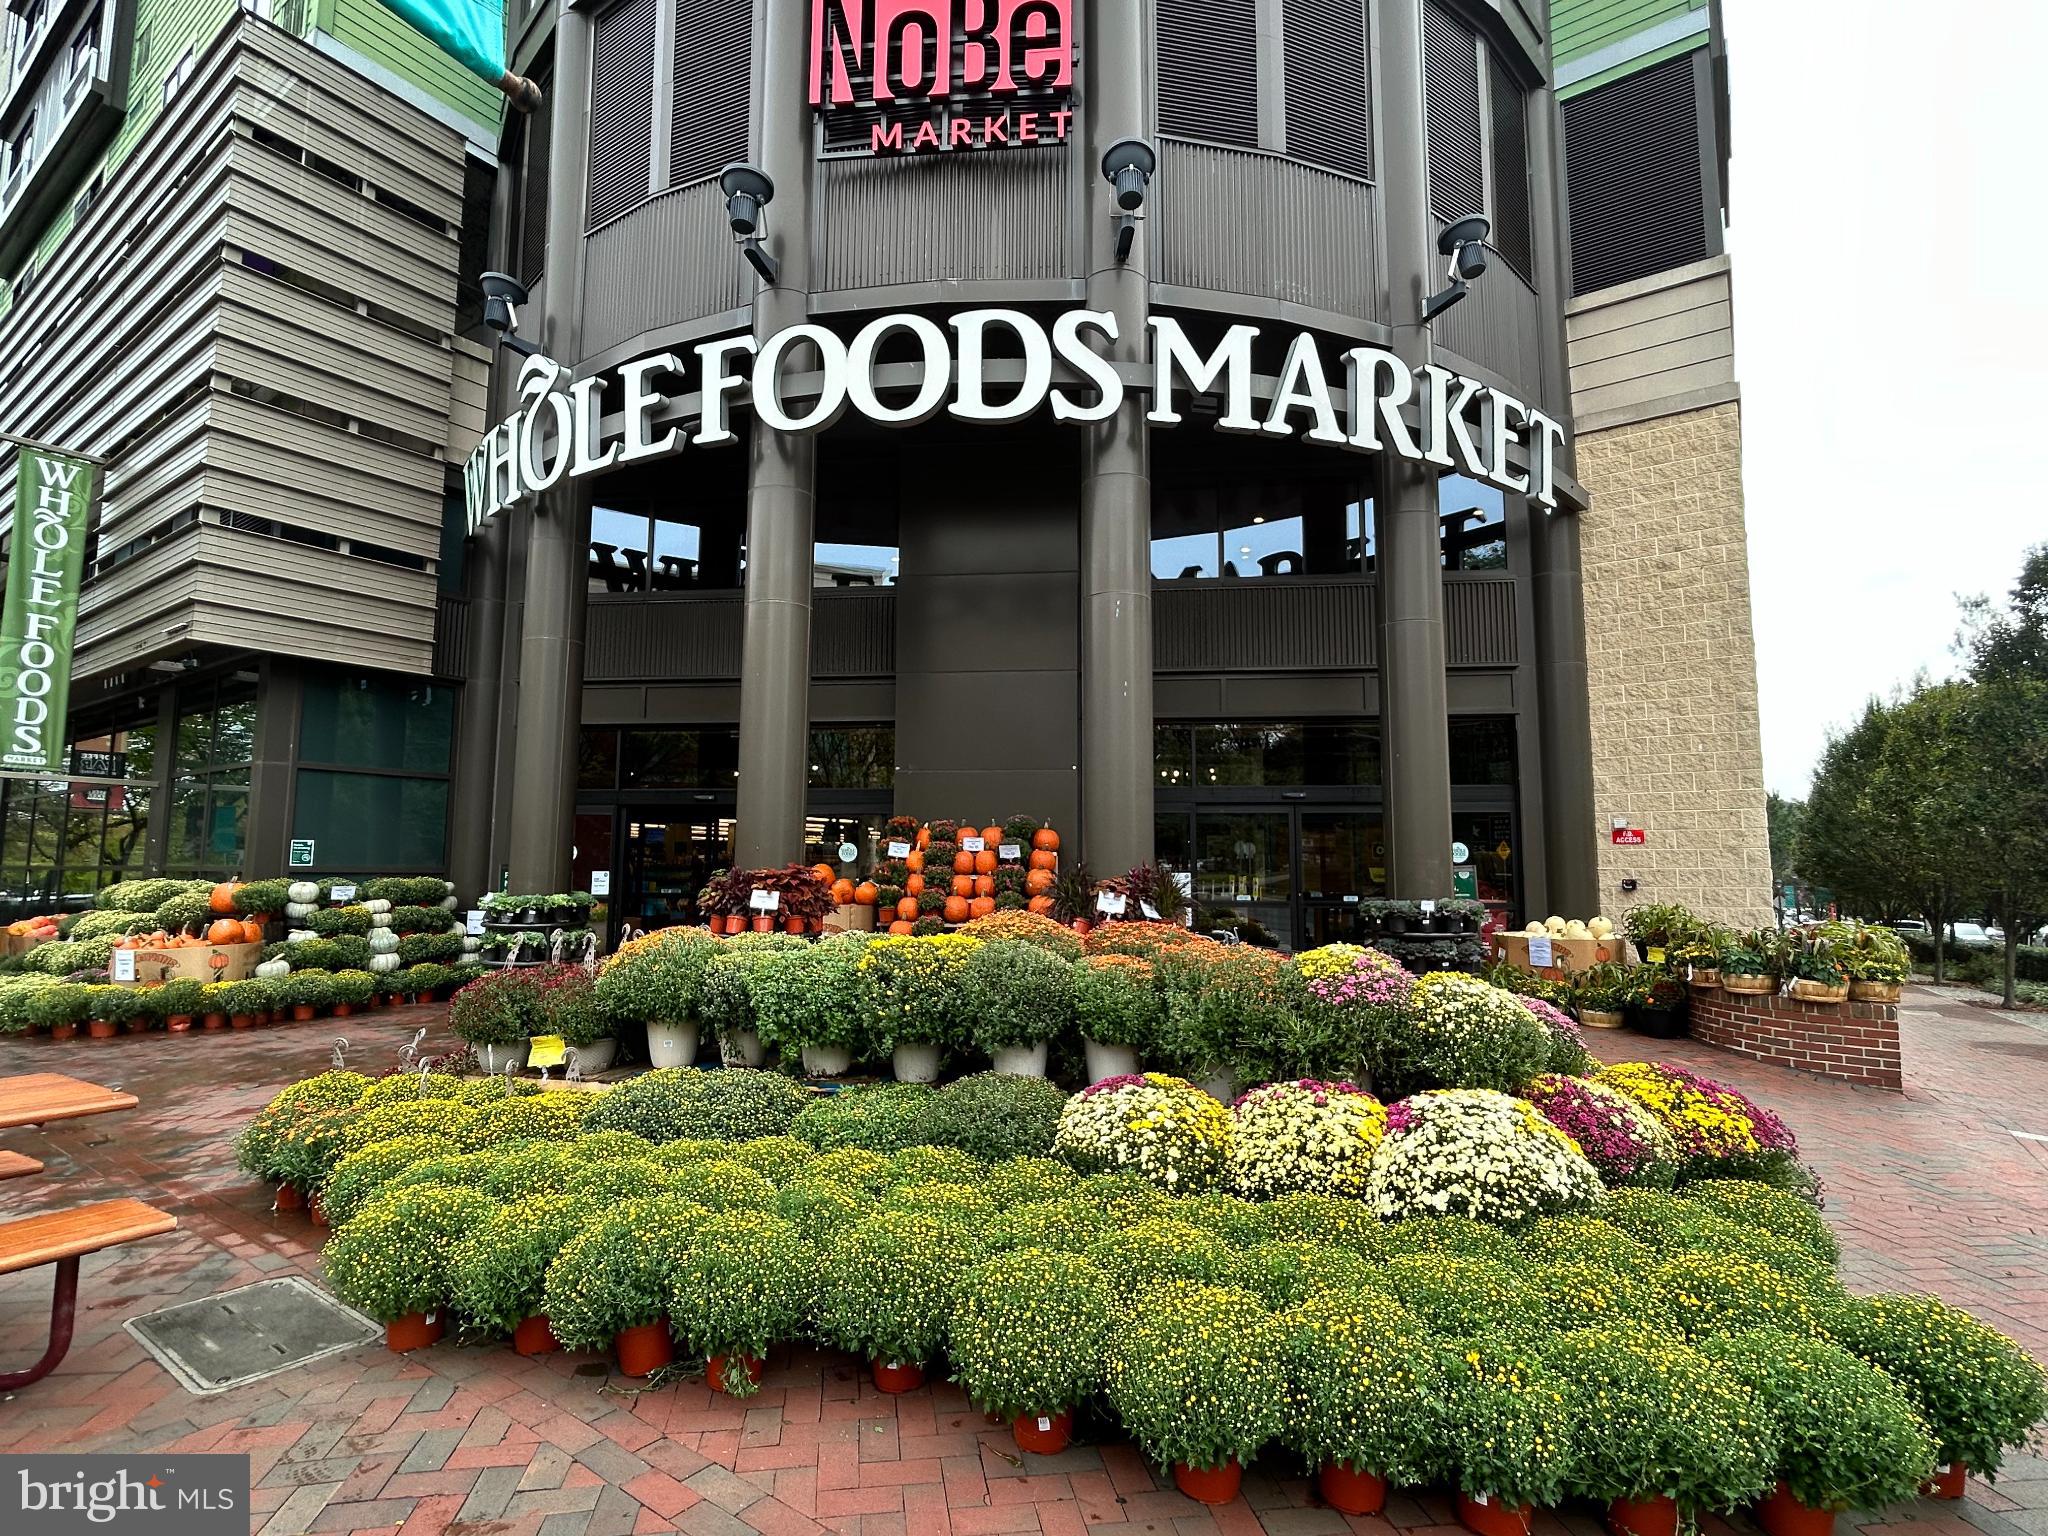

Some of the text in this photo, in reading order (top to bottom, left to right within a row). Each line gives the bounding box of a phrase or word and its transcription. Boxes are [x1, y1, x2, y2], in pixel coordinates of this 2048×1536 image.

[872, 111, 1073, 151] MARKET
[462, 308, 1566, 537] WHOLE FOODS MARKET
[29, 456, 83, 607] WHOLE
[7, 755, 44, 764] MARKET
